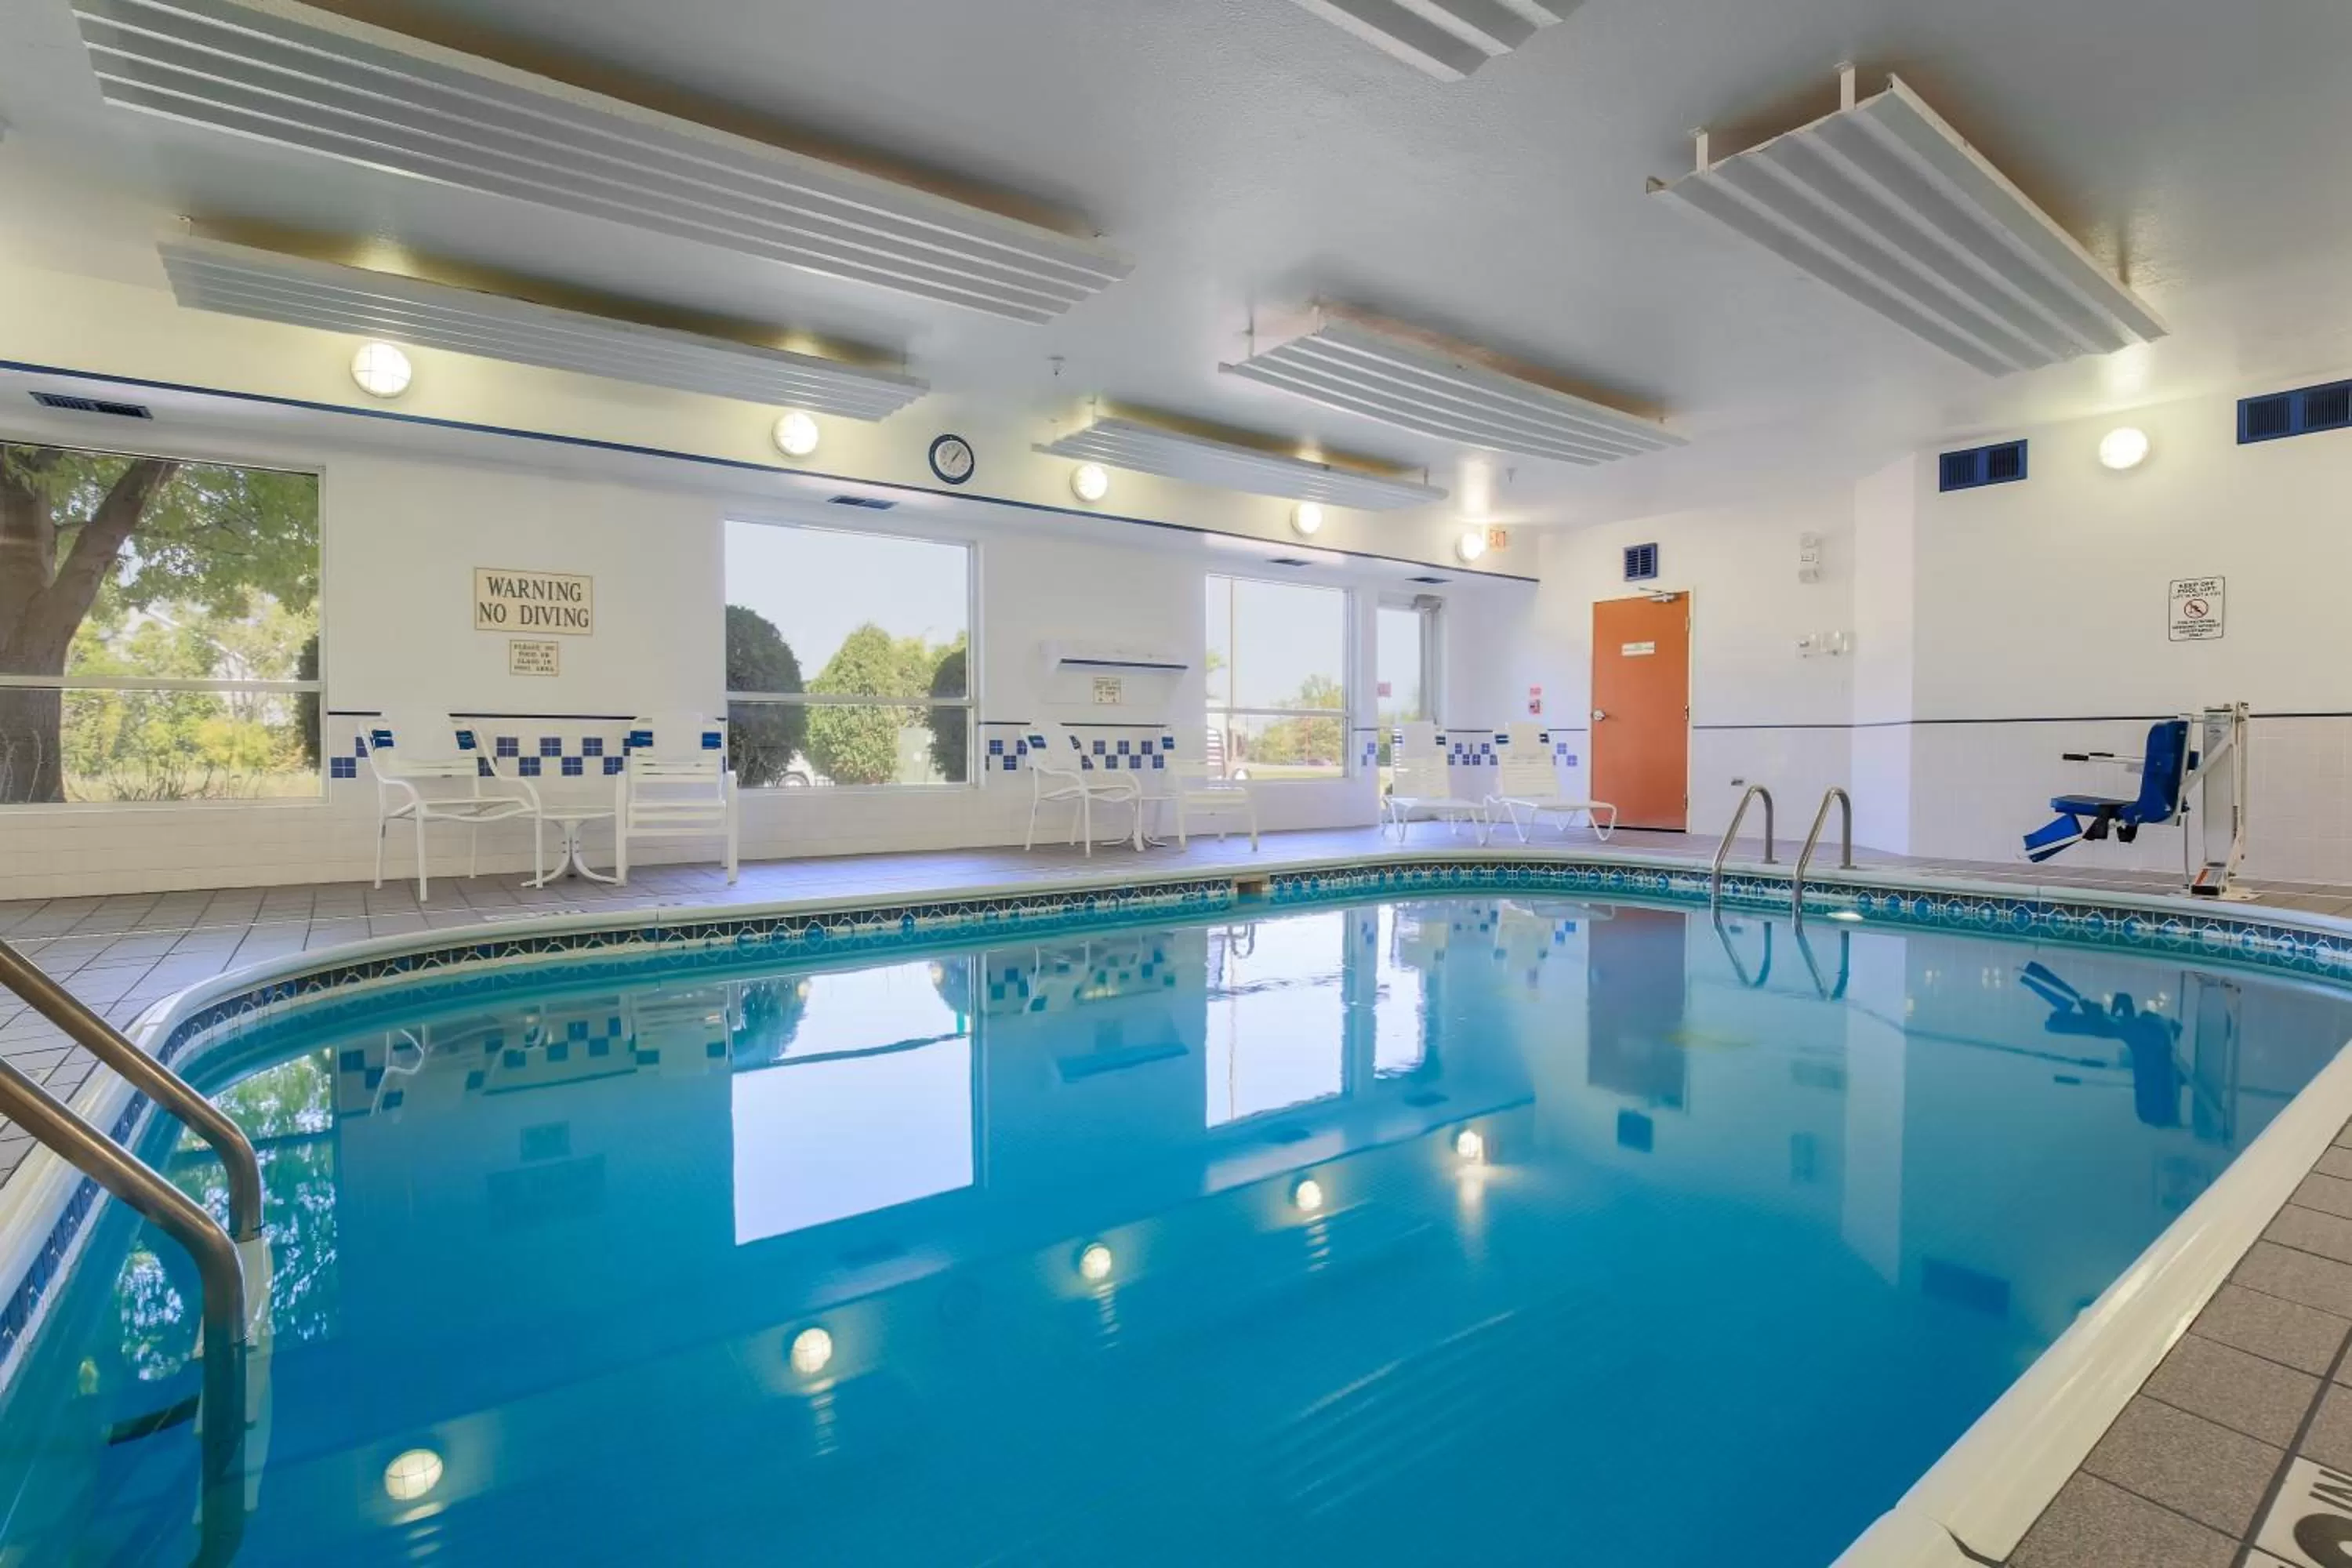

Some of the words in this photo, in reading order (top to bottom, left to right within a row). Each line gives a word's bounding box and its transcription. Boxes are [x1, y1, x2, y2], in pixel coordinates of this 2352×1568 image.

[487, 576, 582, 602] WARNING
[479, 601, 506, 623] NO
[520, 604, 589, 628] DIVING
